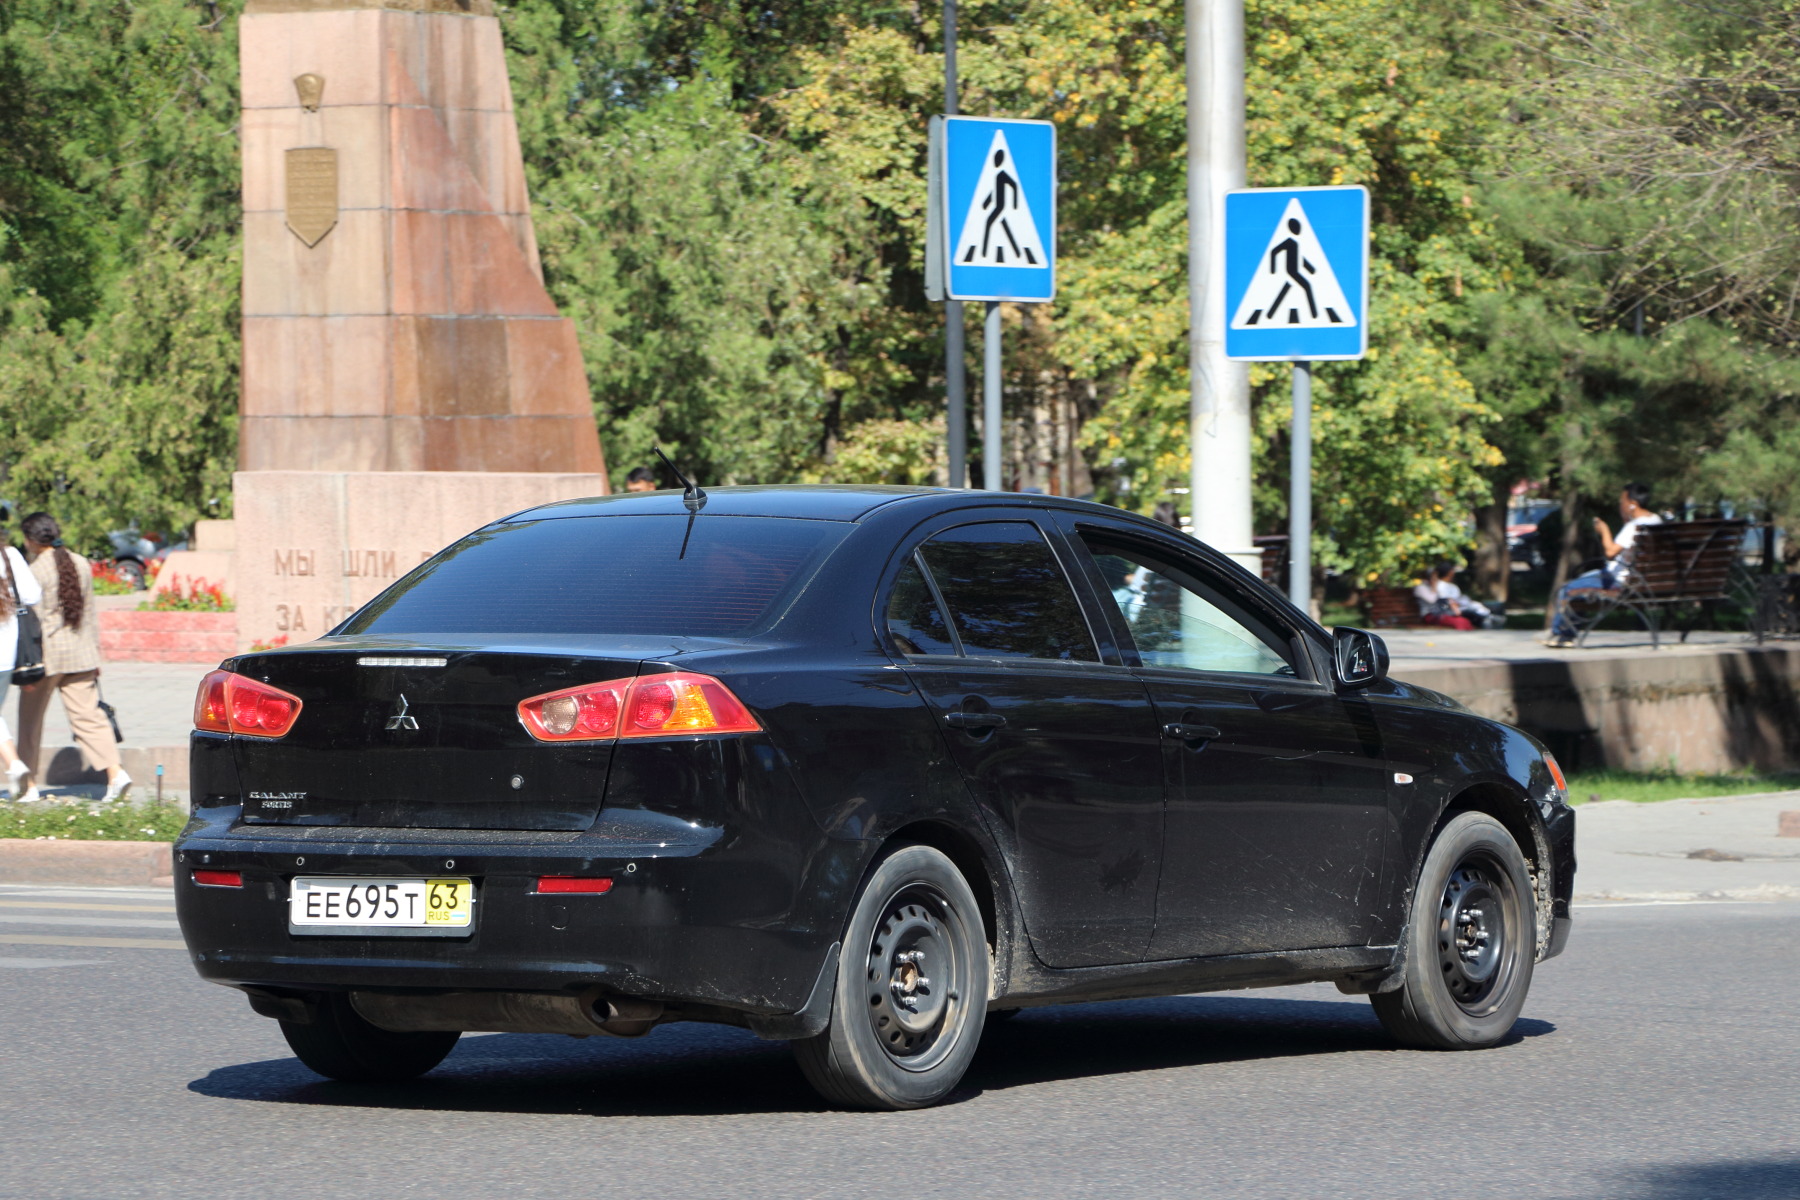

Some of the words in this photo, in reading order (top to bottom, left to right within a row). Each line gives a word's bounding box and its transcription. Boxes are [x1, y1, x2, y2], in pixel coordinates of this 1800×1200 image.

[274, 549, 316, 577] МЫ
[341, 550, 397, 578] ШЛИ
[275, 604, 307, 631] ЗА
[249, 791, 307, 799] GALANT
[429, 883, 458, 909] 63
[428, 911, 450, 921] RUS
